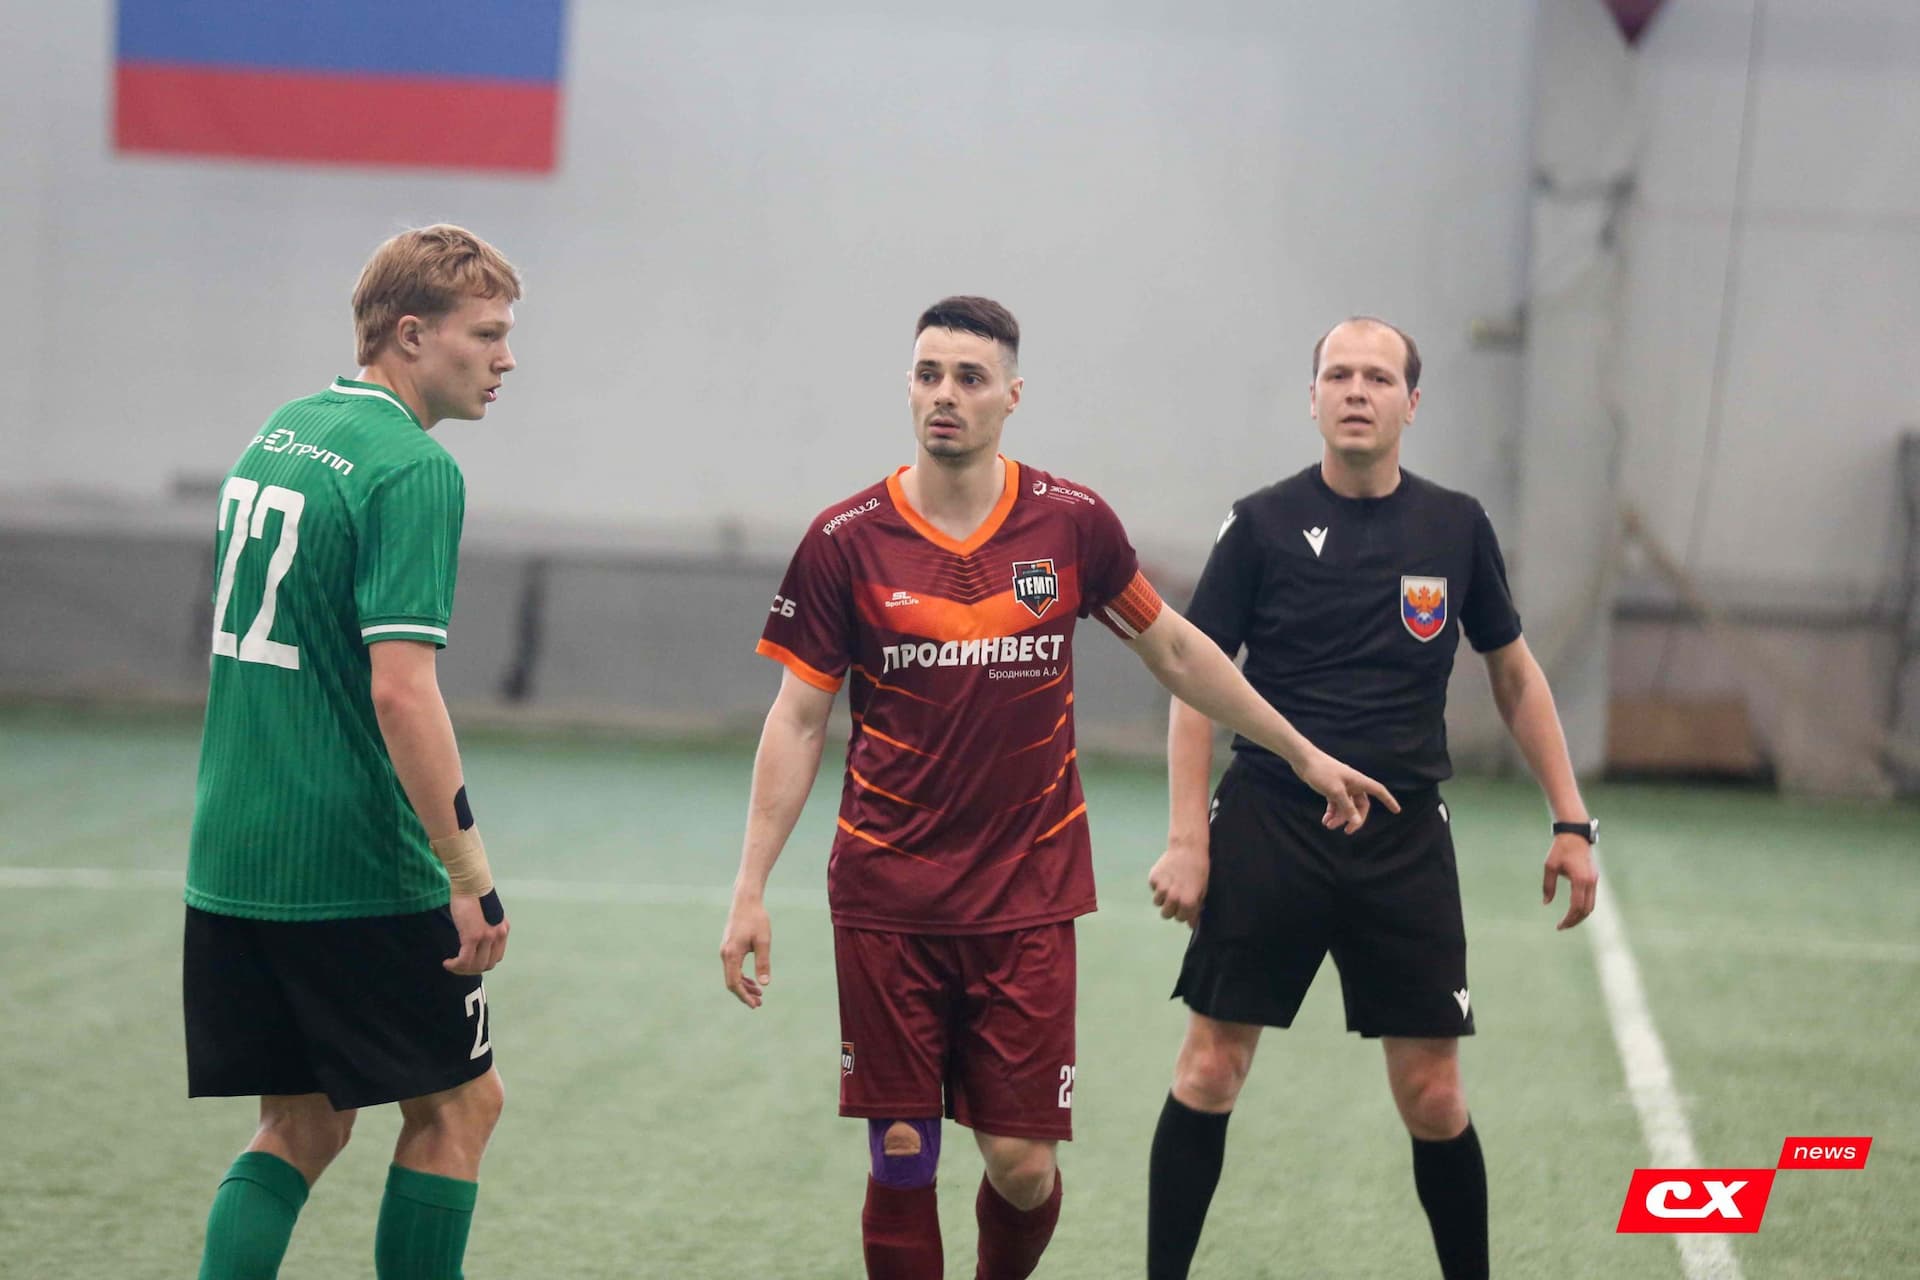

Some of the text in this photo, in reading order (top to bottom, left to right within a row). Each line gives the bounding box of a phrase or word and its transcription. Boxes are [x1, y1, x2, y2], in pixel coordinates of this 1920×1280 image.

[287, 442, 355, 477] ГРУПП
[212, 476, 306, 671] 22
[1017, 575, 1055, 597] ТЕМП
[882, 634, 1065, 674] ПРОДИНВЕСТ
[988, 668, 1041, 681] Бродников
[1058, 1064, 1076, 1108] 2
